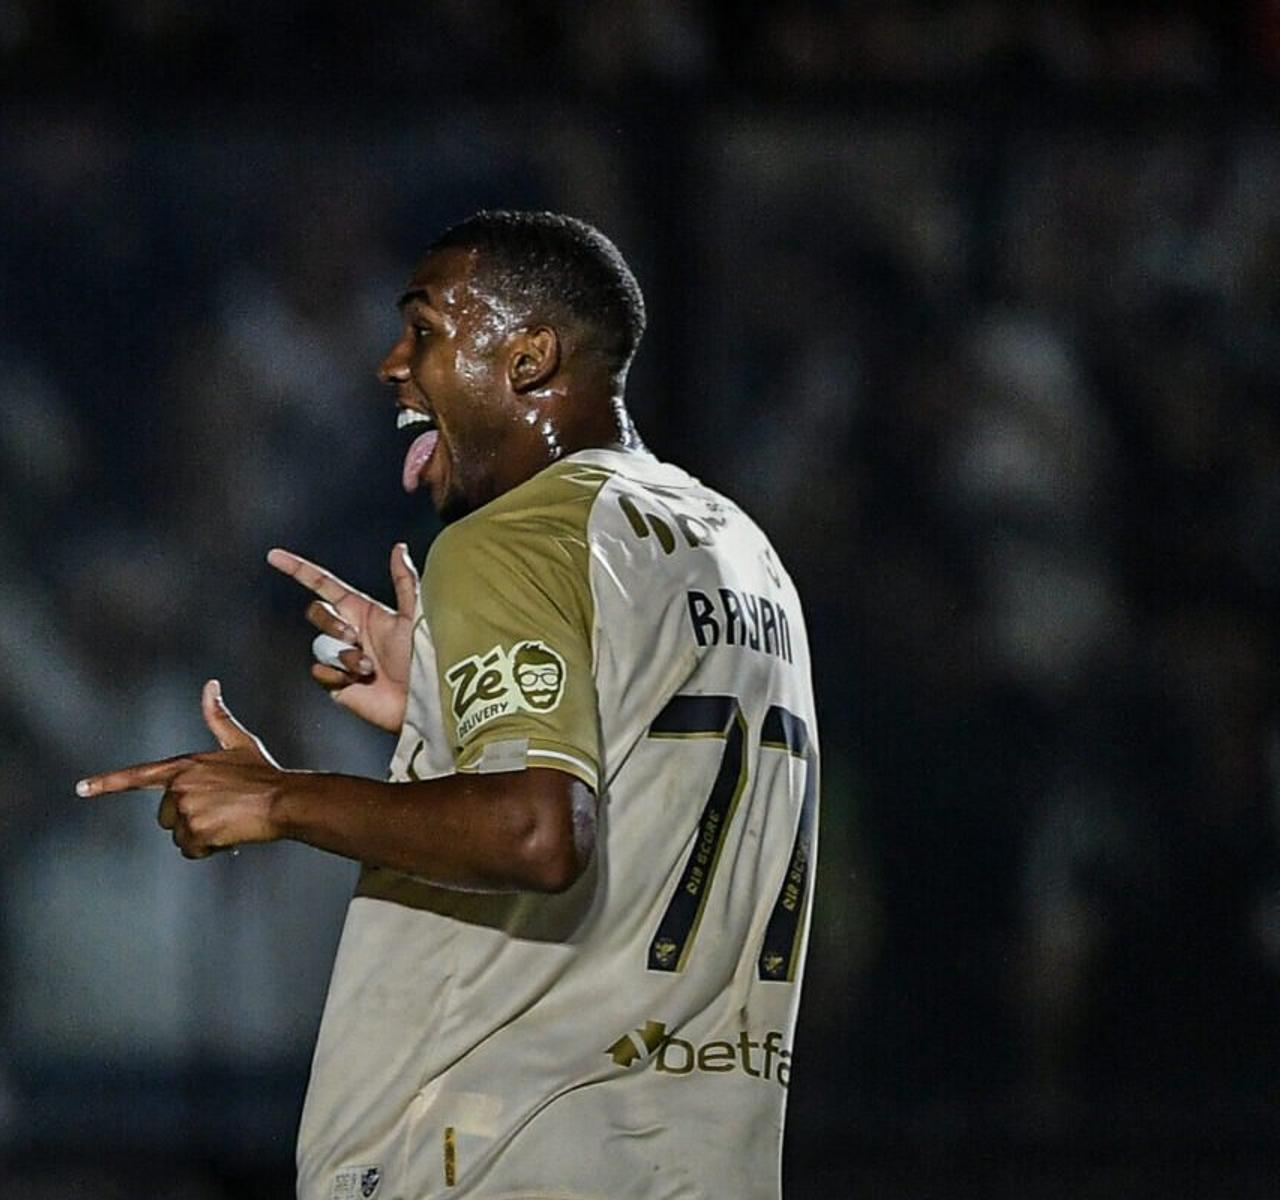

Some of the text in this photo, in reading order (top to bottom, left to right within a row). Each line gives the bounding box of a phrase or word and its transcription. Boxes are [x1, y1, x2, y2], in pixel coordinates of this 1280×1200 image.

[687, 588, 793, 665] RAYAN
[449, 652, 508, 719] Zé
[459, 702, 508, 738] DELIVERY
[647, 695, 819, 983] 77
